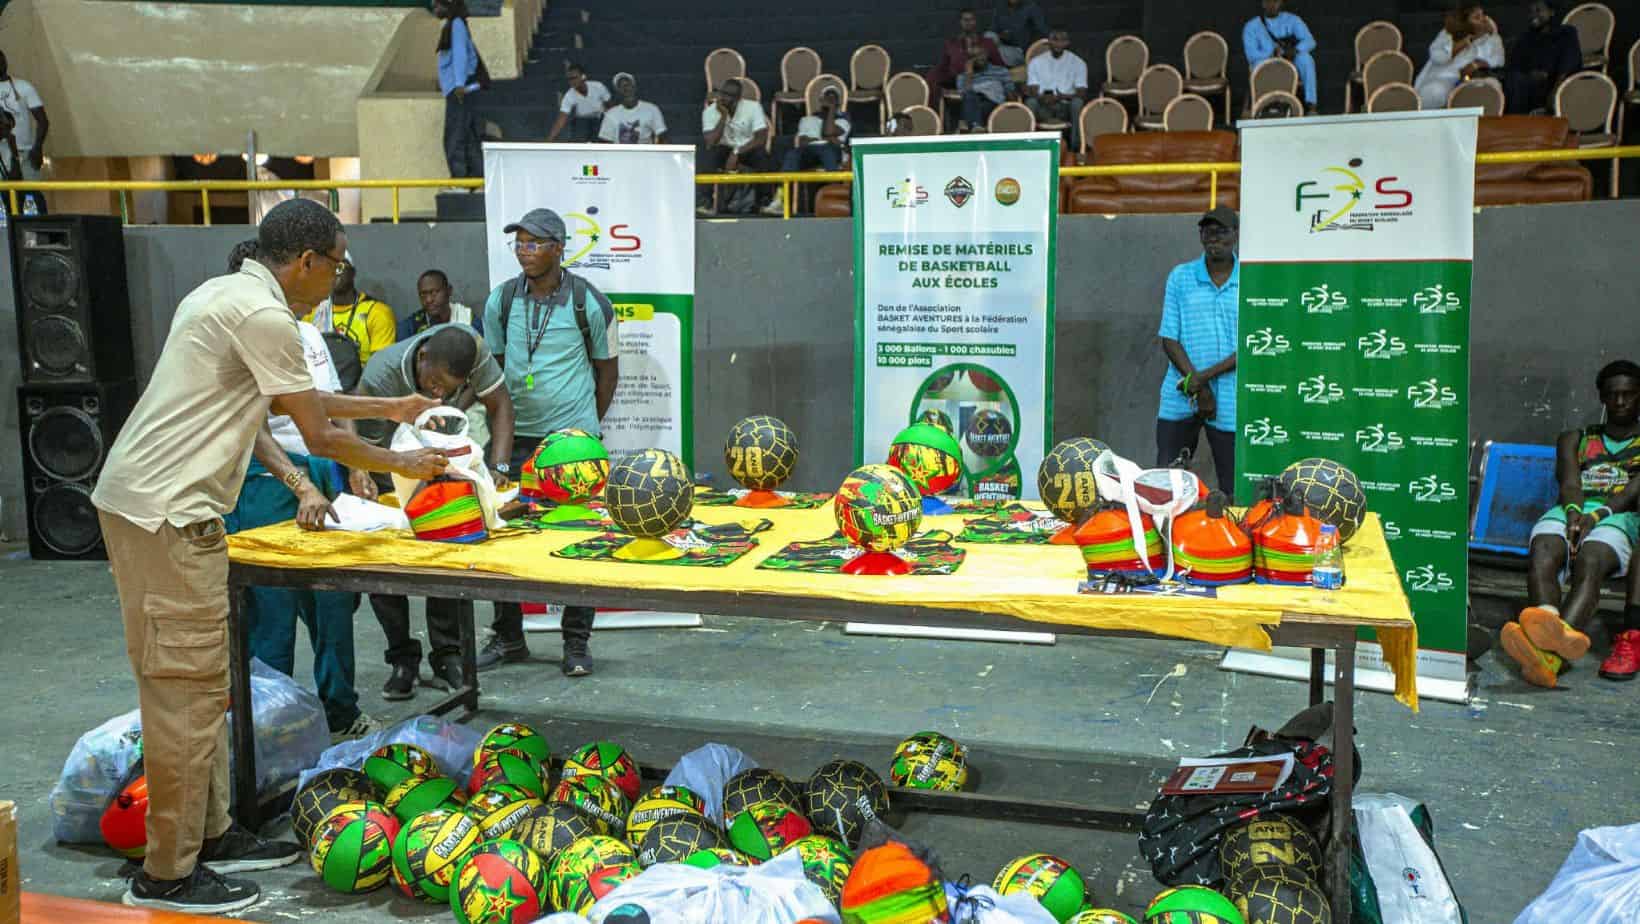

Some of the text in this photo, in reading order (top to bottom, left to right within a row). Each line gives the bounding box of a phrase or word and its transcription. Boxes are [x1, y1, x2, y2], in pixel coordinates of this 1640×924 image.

[879, 241, 1033, 256] REMISE DE MATÉRIELS
[898, 261, 1011, 272] DE BASKETBALL
[912, 275, 998, 288] AUX ÉCOLES
[878, 304, 894, 312] Don
[896, 304, 907, 312] de
[878, 314, 909, 322] BASKET
[912, 314, 962, 322] AVENTURES
[941, 326, 964, 334] Sport
[966, 326, 999, 334] scolaire
[904, 345, 936, 353] Ballons
[950, 346, 967, 354] 000
[969, 346, 1014, 354] chasubles
[908, 357, 930, 365] plots
